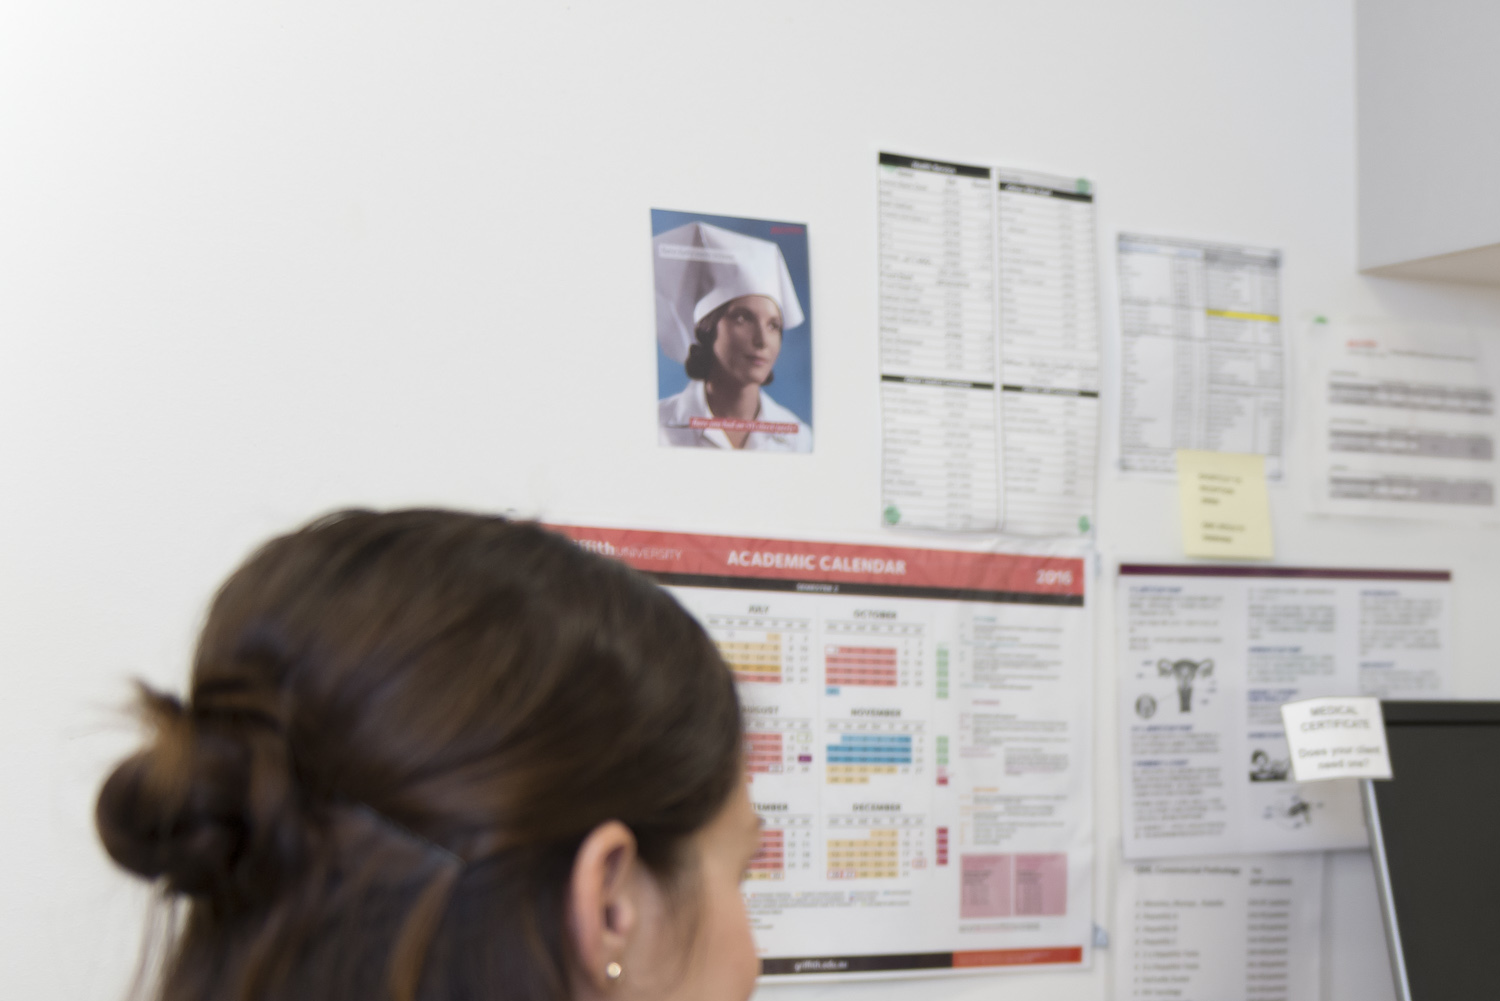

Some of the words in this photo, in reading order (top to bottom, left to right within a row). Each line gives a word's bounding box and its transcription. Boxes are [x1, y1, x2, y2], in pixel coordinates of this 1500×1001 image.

[573, 539, 615, 556] ffith
[615, 546, 682, 561] UNIVERSITY
[727, 549, 816, 570] ACADEMIC
[819, 554, 907, 576] CALENDAR
[1035, 569, 1074, 586] 2016
[748, 604, 770, 615] JULY
[853, 609, 898, 621] OCTOBER
[850, 707, 903, 719] NOVEMBER
[1310, 704, 1358, 717] MEDICAL
[1300, 718, 1370, 733] CERTIFICATE
[752, 802, 789, 813] TEMBER
[852, 802, 903, 813] DECEMBER
